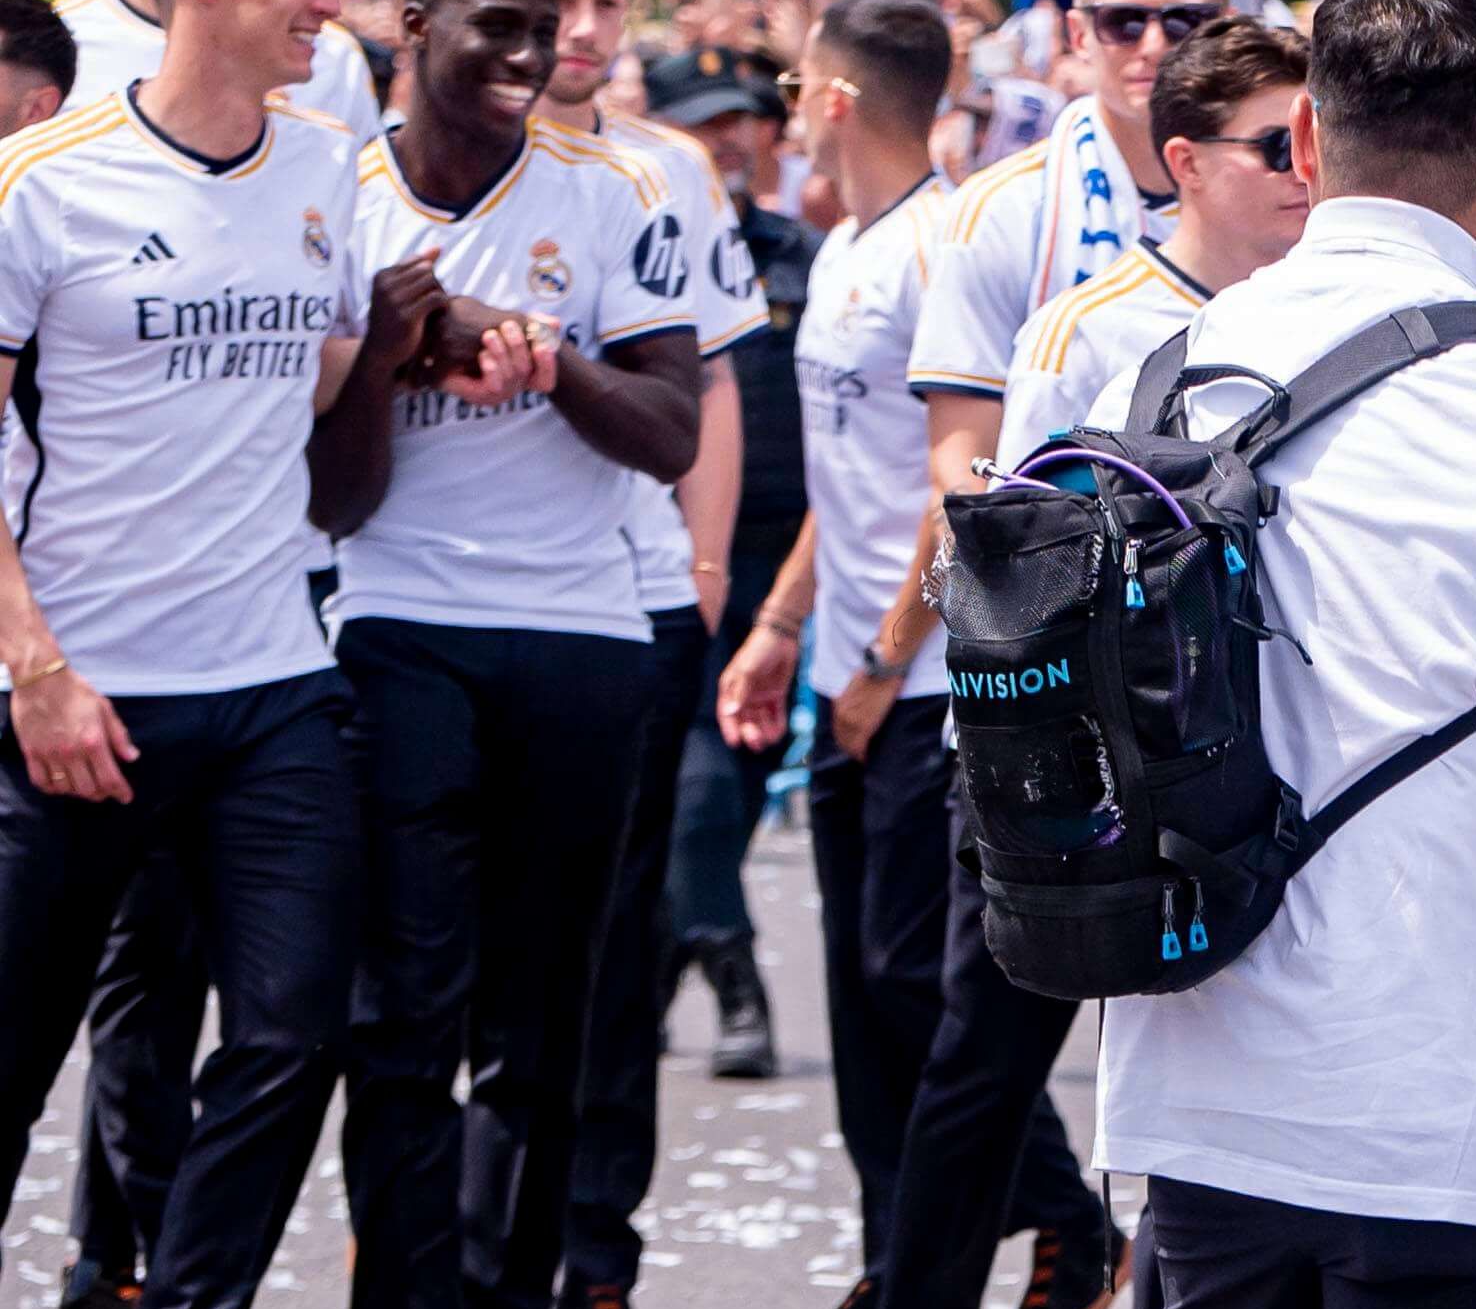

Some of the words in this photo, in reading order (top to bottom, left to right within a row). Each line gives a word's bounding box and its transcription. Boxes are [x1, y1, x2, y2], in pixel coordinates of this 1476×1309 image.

[133, 286, 333, 341] Emirates
[166, 343, 213, 382] FLY
[219, 340, 309, 379] BETTER
